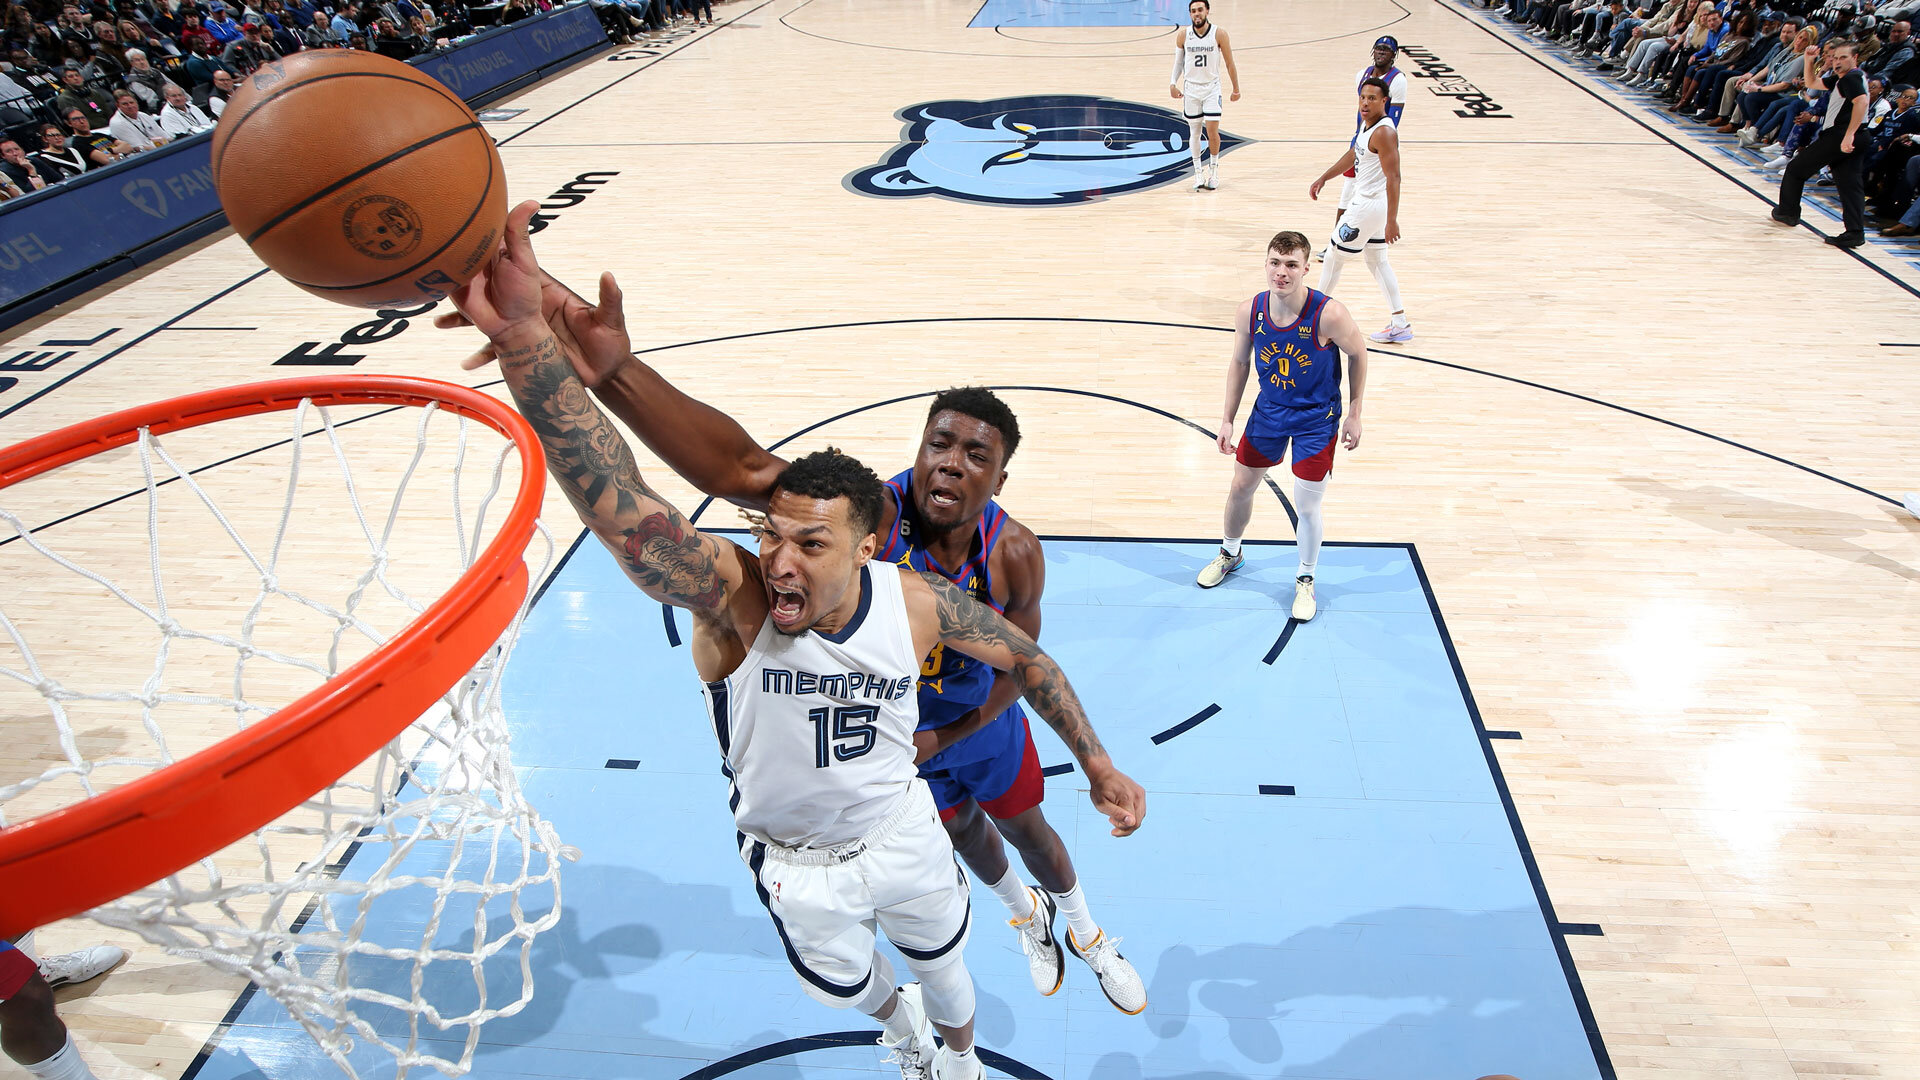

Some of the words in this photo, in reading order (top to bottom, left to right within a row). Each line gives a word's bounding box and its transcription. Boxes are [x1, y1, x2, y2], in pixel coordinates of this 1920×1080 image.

[458, 49, 514, 80] FANDUEL
[1194, 54, 1207, 67] 21
[1257, 312, 1263, 320] 6
[1260, 342, 1281, 364] MILE
[1284, 343, 1313, 368] HIGH
[1277, 357, 1290, 377] 0
[1270, 373, 1297, 390] CITY
[901, 519, 911, 536] 6
[762, 668, 912, 700] MEMPHIS
[808, 705, 880, 769] 15
